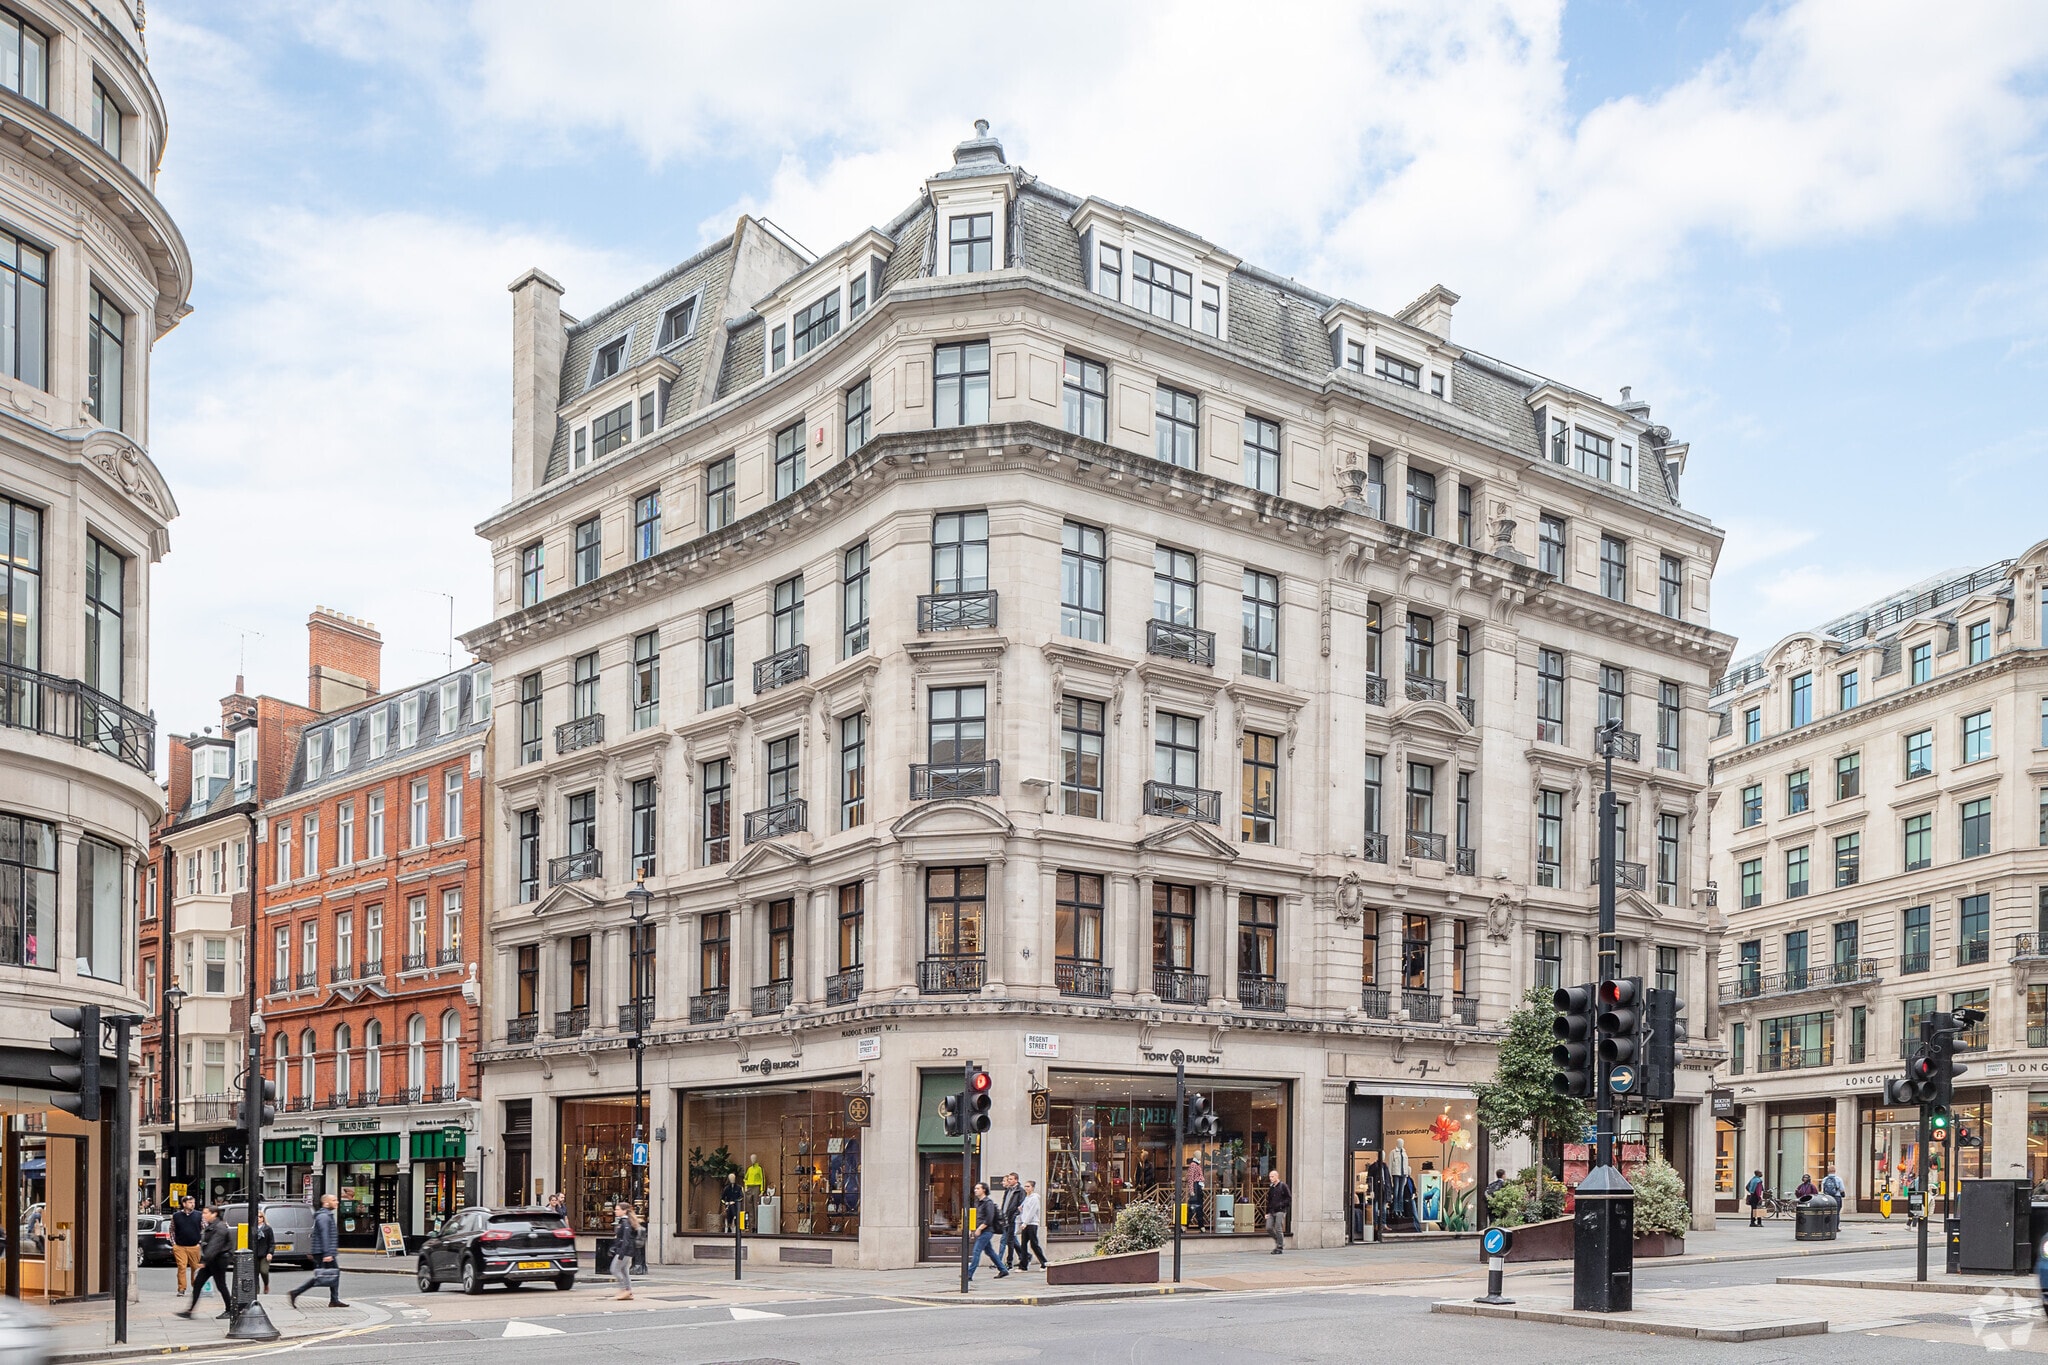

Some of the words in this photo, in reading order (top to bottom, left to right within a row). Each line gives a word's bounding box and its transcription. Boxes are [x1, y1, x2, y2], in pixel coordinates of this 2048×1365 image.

[841, 1029, 862, 1038] MADDOX
[864, 1025, 882, 1034] STREET
[942, 1048, 958, 1057] 223
[1143, 1052, 1169, 1061] TORY
[1186, 1054, 1220, 1064] BURCH
[740, 1064, 760, 1072] TORY
[773, 1060, 800, 1070] BURCH
